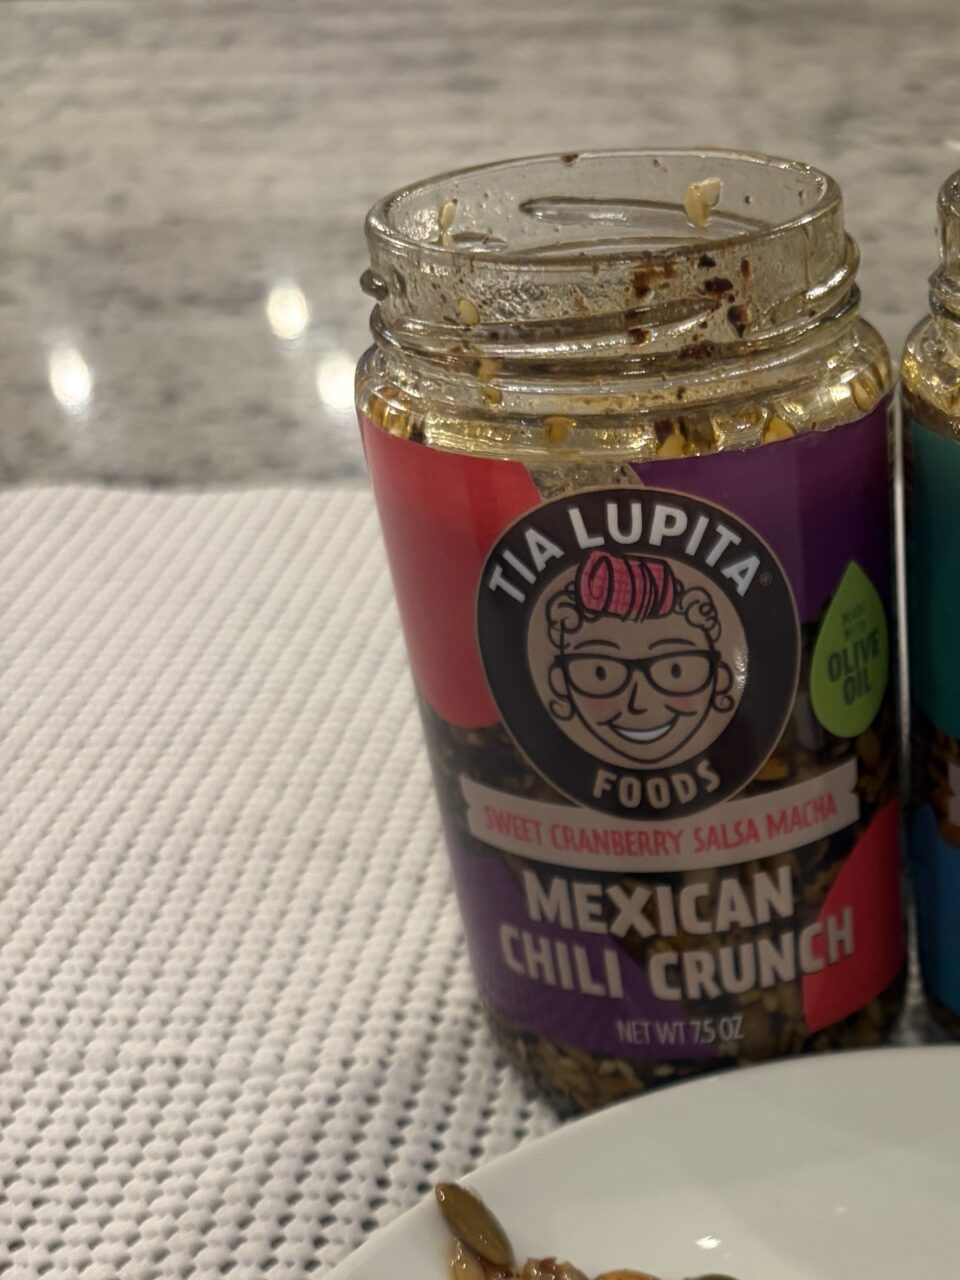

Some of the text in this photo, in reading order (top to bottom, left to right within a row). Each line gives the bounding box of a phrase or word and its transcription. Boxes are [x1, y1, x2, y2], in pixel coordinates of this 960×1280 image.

[489, 503, 761, 603] TIA LUPITA
[826, 628, 881, 683] OLIVE
[842, 667, 872, 706] OIL
[593, 759, 721, 809] FOODS
[484, 792, 838, 856] SWEET CRANBERRY SALSA MACHA
[522, 866, 794, 939] MEXICAN
[500, 906, 854, 1001] CHILI CRUNCH
[616, 1019, 651, 1045] NET
[655, 1020, 686, 1045] WT
[719, 1015, 745, 1041] OZ
